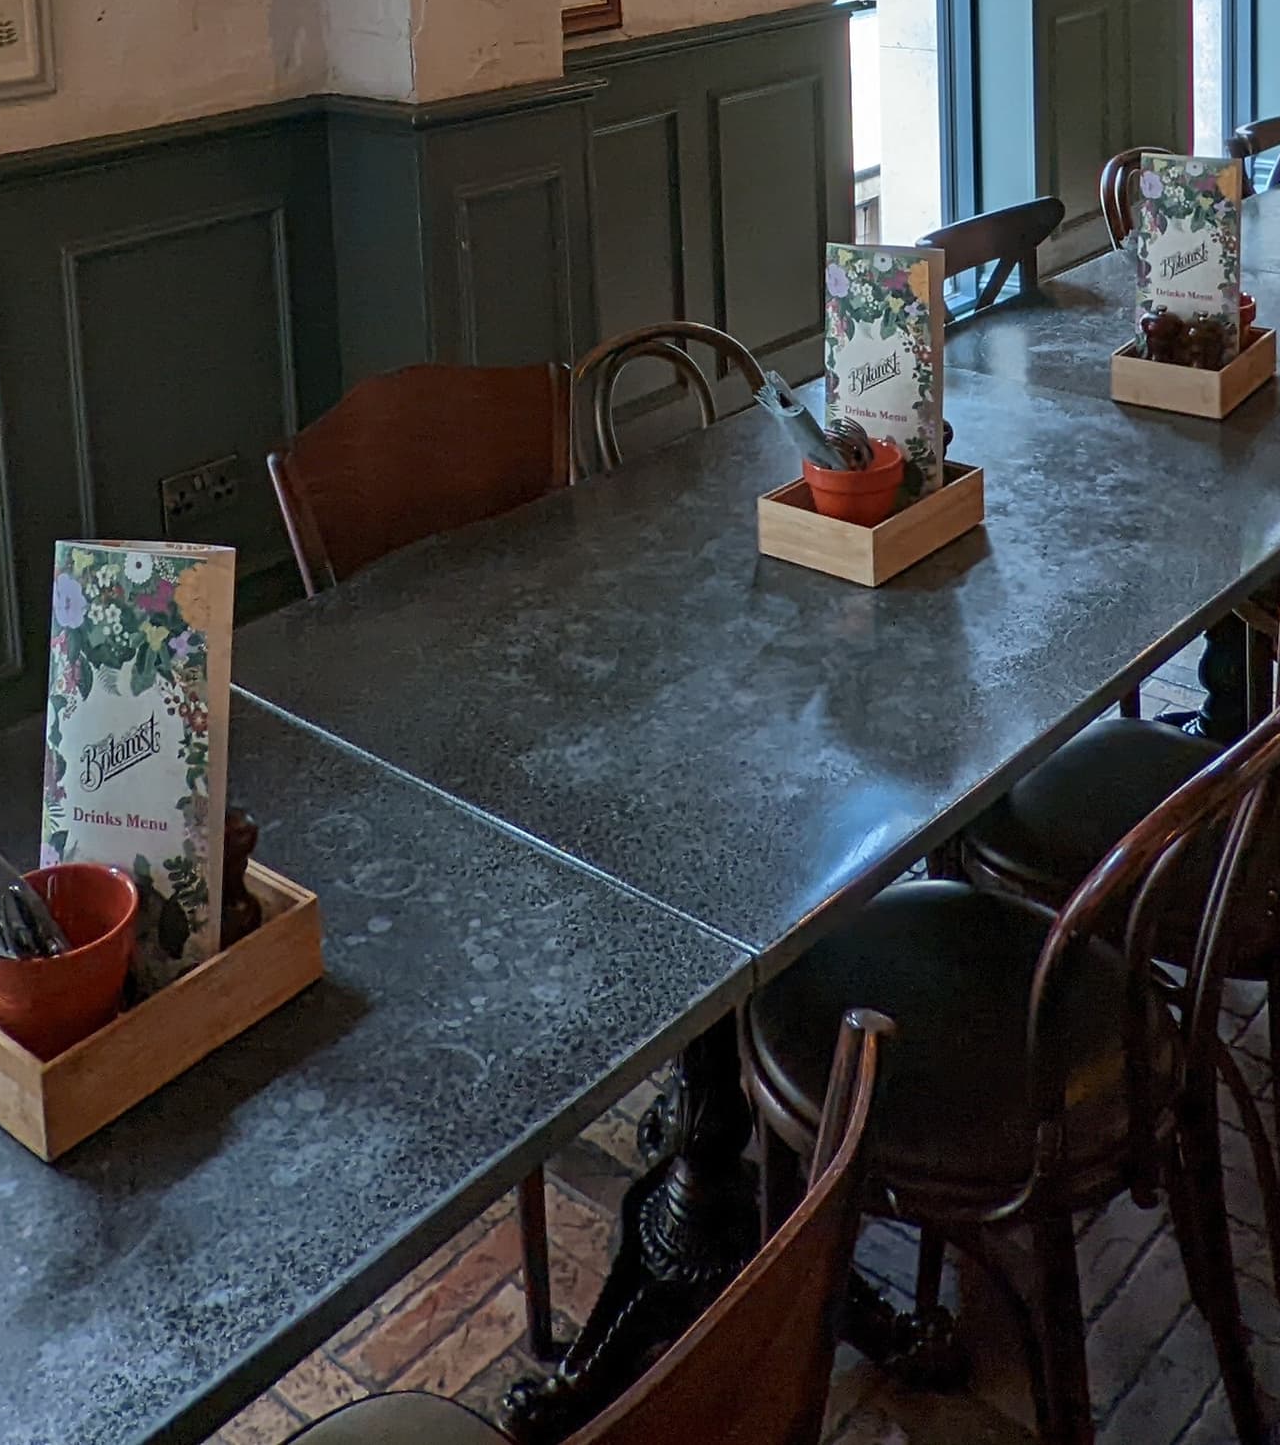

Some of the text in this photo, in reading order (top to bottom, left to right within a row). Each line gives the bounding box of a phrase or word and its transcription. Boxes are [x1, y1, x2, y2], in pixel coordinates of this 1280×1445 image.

[845, 405, 908, 423] Drinks Menu
[80, 710, 161, 793] Botanist
[73, 806, 168, 831] Drinks Menu
